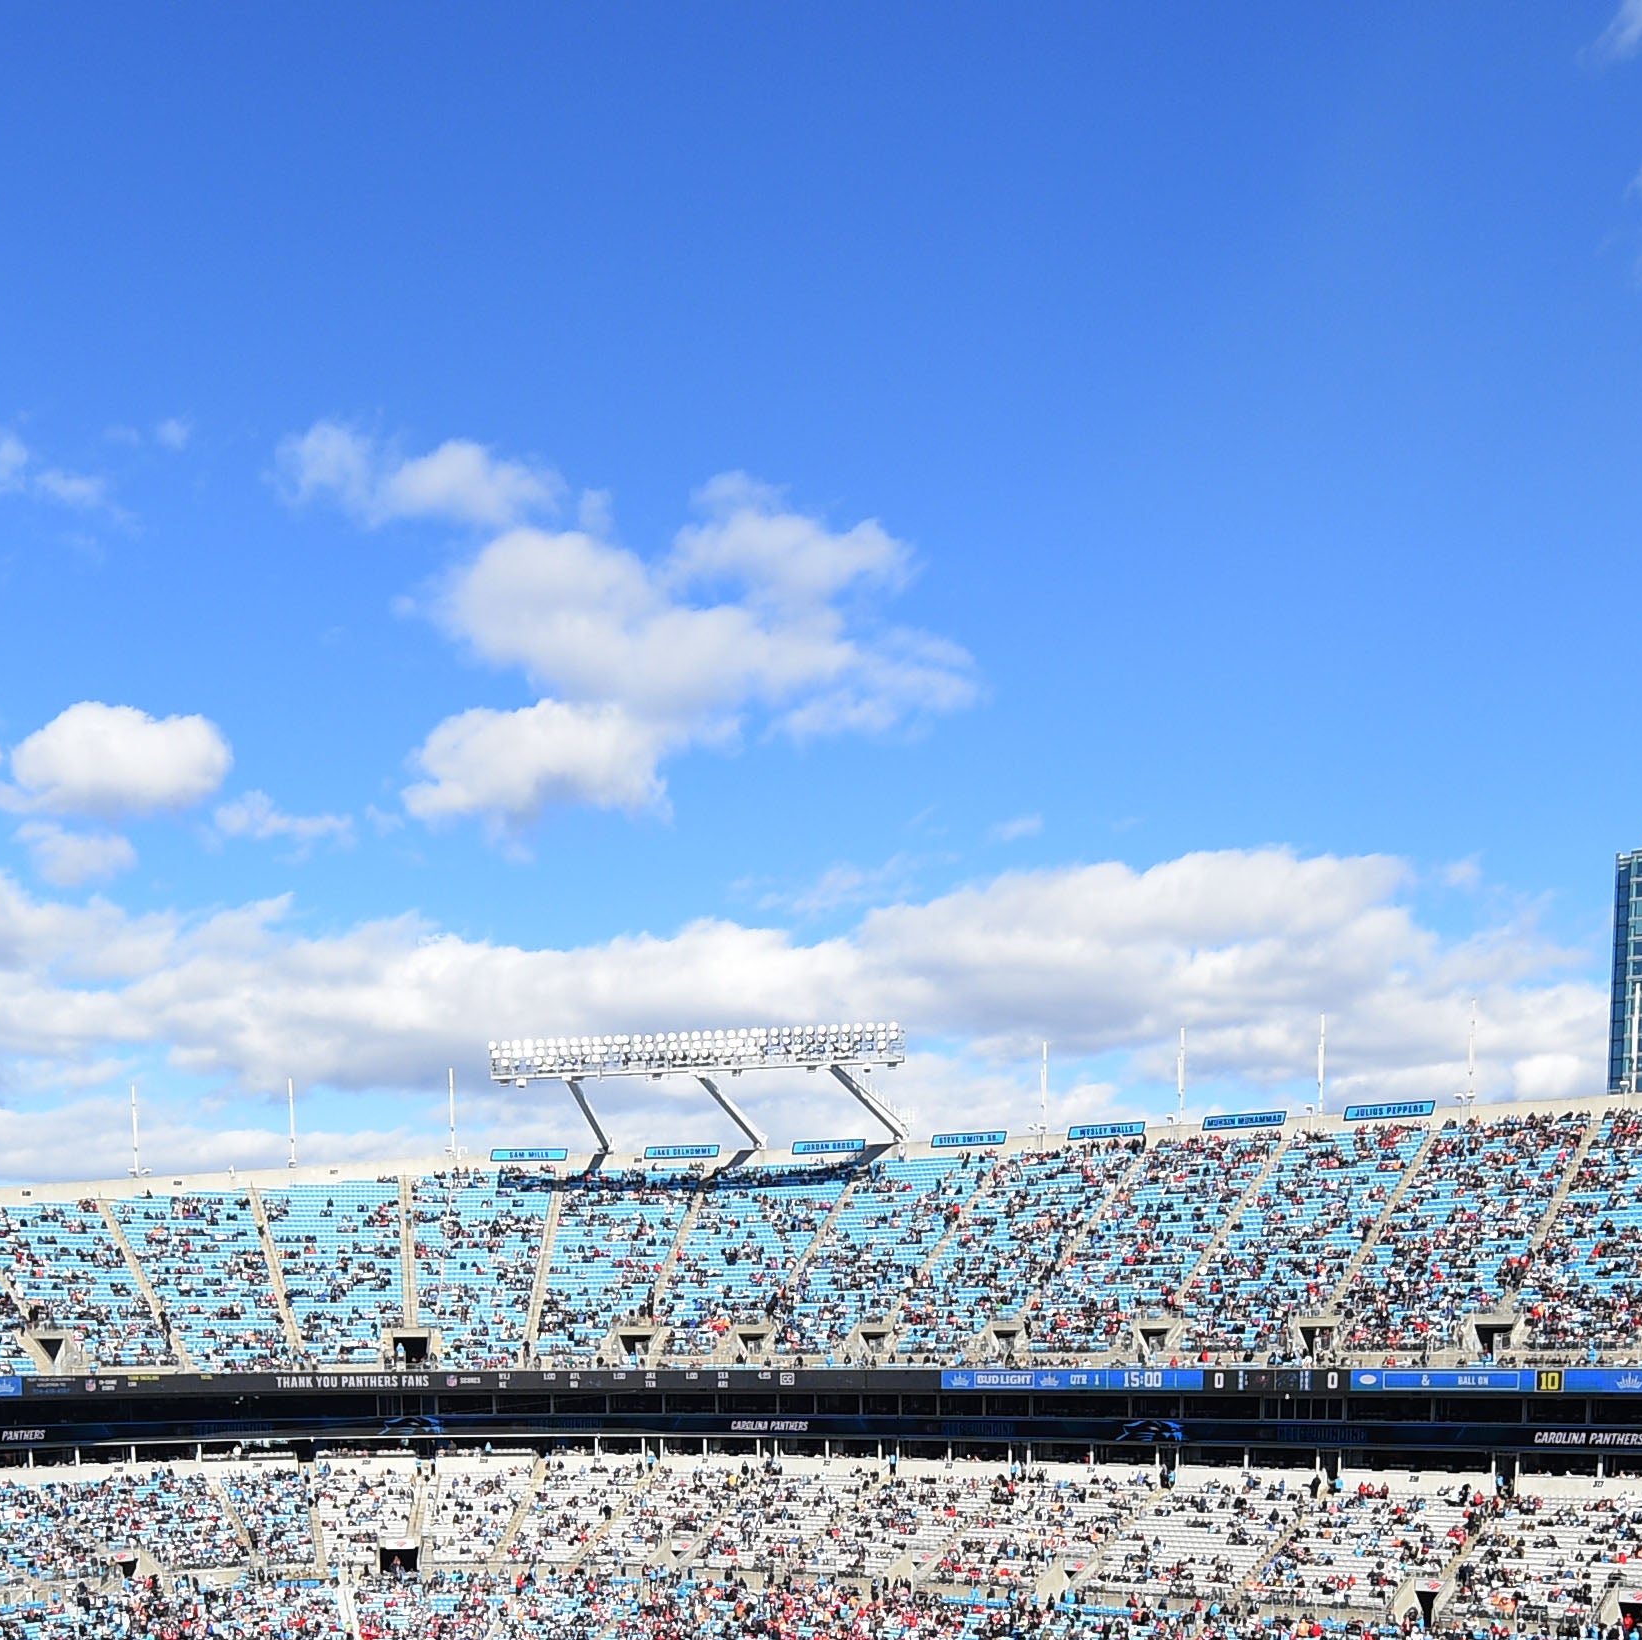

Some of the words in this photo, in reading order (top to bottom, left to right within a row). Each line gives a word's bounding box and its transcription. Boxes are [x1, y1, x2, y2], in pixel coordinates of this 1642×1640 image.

[1386, 1106, 1424, 1115] PEPPERS
[1110, 1126, 1133, 1134] WALLS
[962, 1135, 984, 1143] SMITH
[803, 1143, 830, 1151] JORDAN
[276, 1376, 314, 1388] THANK
[316, 1376, 337, 1388] YOU
[341, 1375, 398, 1388] PANTHERS
[402, 1375, 430, 1387] FANS
[977, 1373, 1001, 1386] BUD
[1001, 1373, 1033, 1386] LIGHT
[1069, 1374, 1088, 1385] QTR
[1094, 1373, 1100, 1385] 1
[1123, 1372, 1162, 1388] 15:00
[1214, 1372, 1224, 1388] 0
[1327, 1372, 1338, 1389] 0
[1421, 1374, 1430, 1386] &
[1458, 1375, 1475, 1386] BALL
[1540, 1372, 1559, 1390] 10
[730, 1420, 768, 1431] CAROLINA
[770, 1420, 808, 1431] PANTHERS
[1, 1429, 46, 1441] PANTHERS
[1534, 1432, 1586, 1445] CAROLINA
